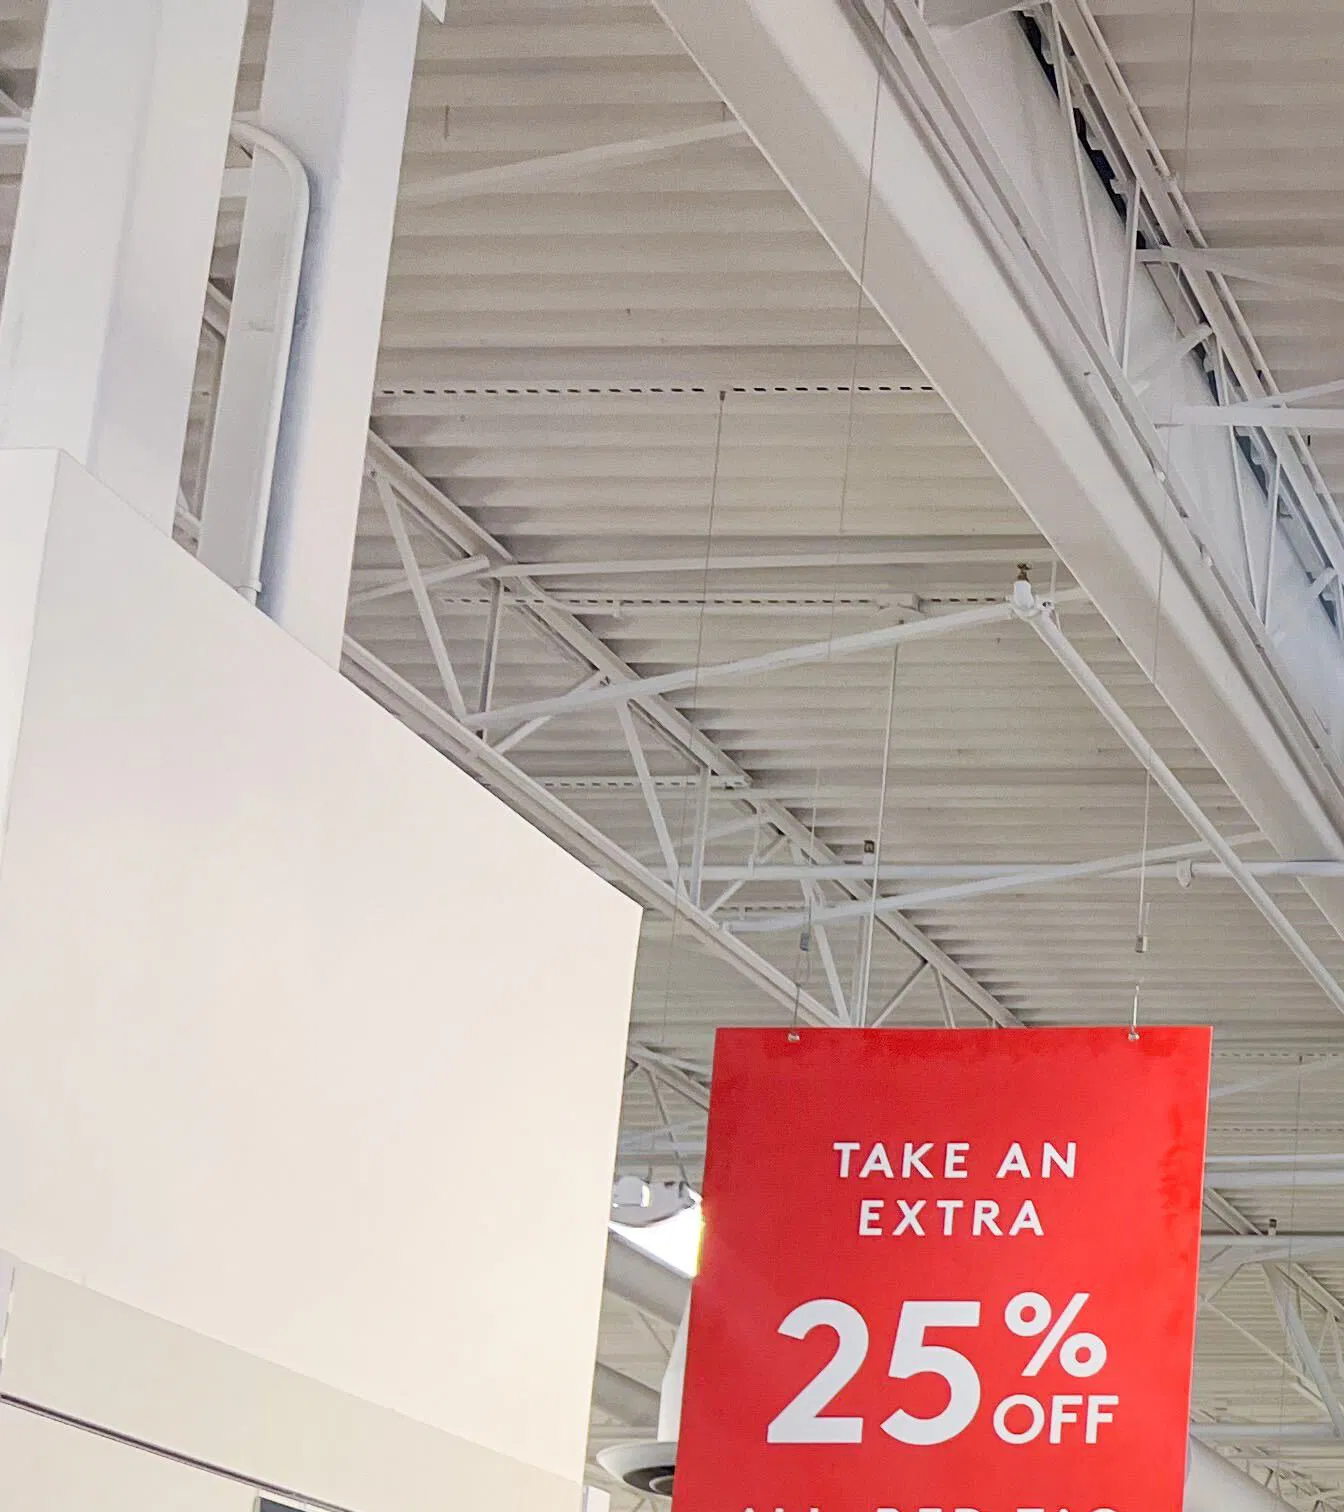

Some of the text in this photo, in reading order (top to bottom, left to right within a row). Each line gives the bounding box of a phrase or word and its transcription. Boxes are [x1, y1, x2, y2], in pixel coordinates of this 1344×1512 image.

[834, 1142, 1077, 1178] TAKE AN
[859, 1199, 1045, 1236] EXTRA
[993, 1394, 1120, 1445] OFF
